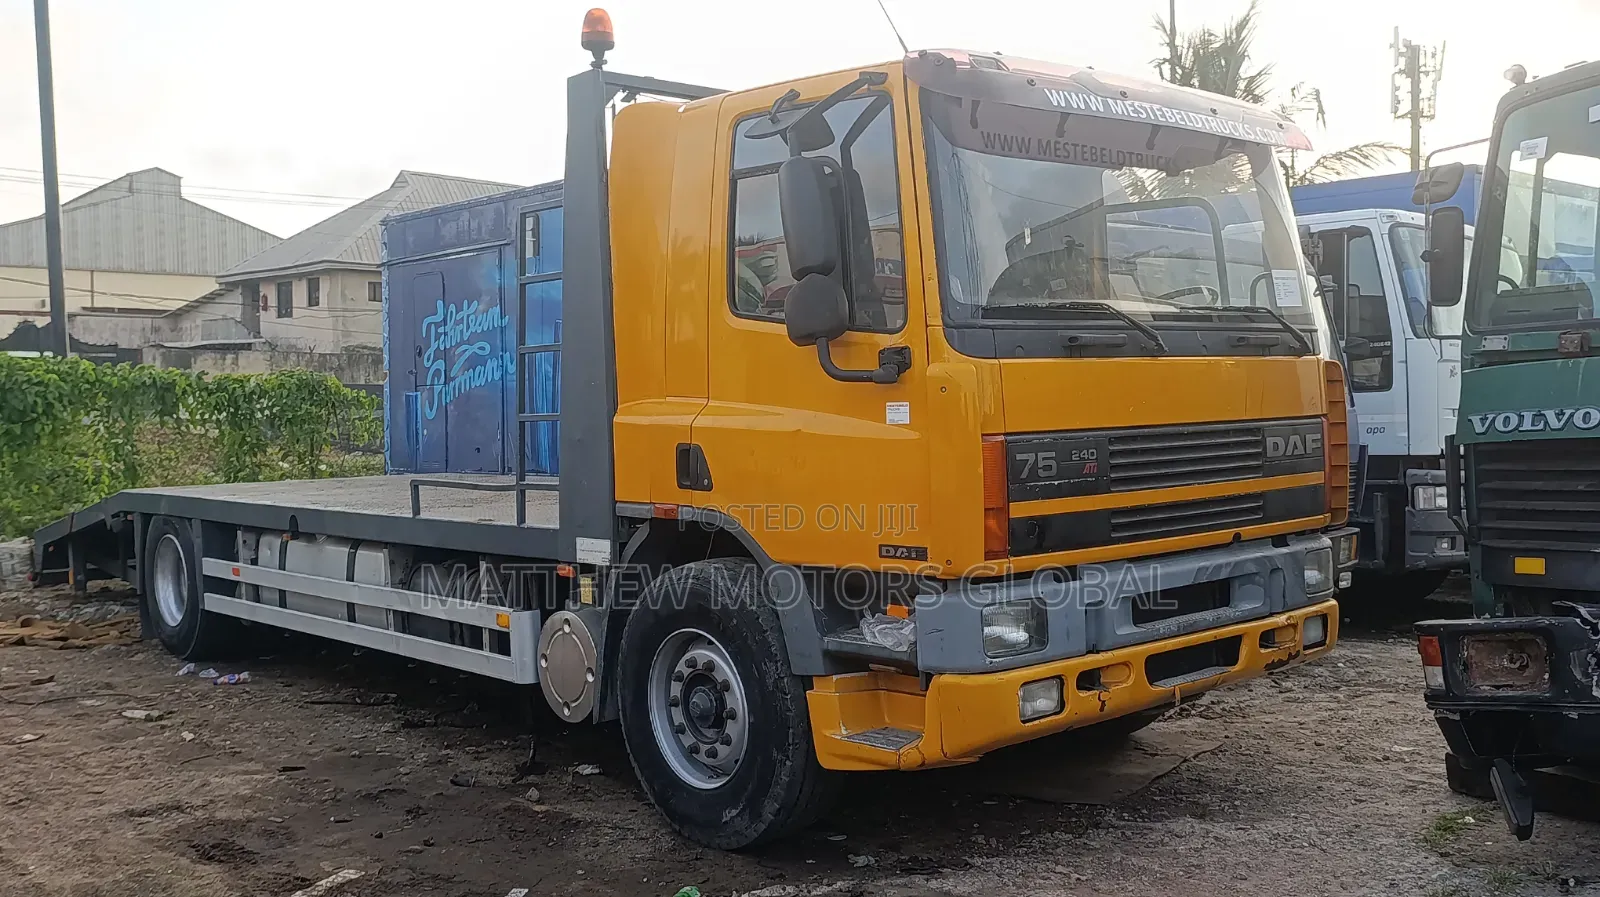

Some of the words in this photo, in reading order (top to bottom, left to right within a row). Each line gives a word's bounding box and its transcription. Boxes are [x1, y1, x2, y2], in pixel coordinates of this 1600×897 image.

[1043, 87, 1104, 113] WWW
[980, 130, 1032, 155] WWW
[1467, 407, 1600, 435] VOLVO
[1071, 448, 1097, 461] 240
[1265, 433, 1322, 458] DAF
[1015, 451, 1058, 479] 75
